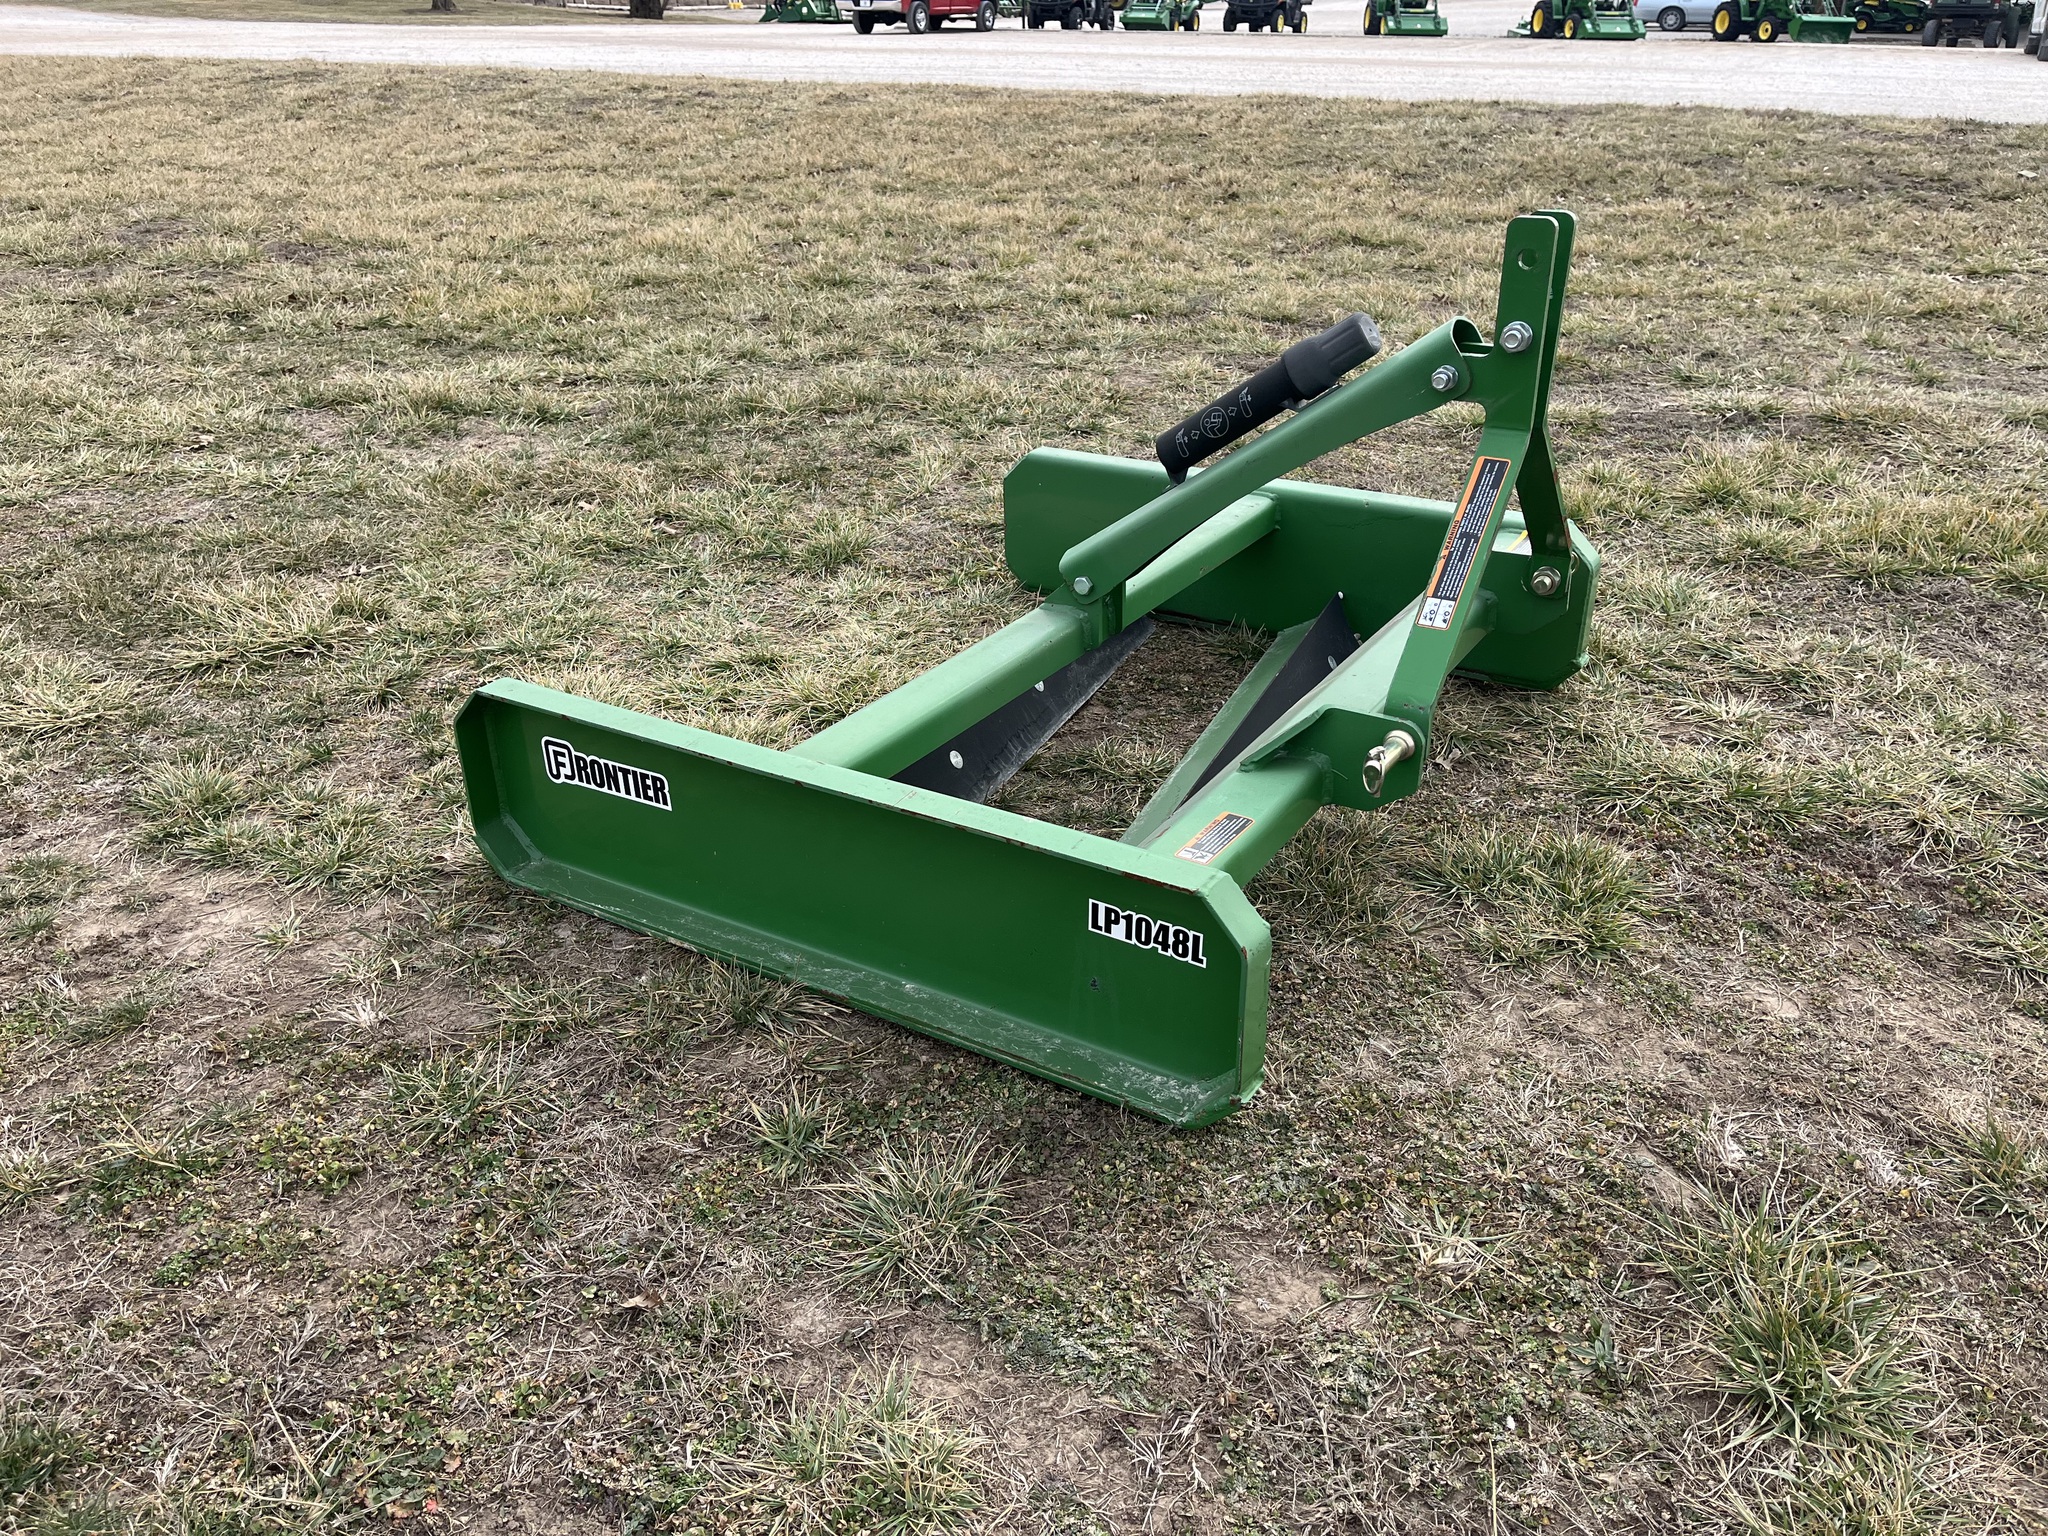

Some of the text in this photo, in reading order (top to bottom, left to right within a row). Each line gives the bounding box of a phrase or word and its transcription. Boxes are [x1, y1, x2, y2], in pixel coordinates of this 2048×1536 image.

[1444, 519, 1460, 551] WARNING
[543, 738, 670, 808] FRONTIER
[1090, 901, 1205, 966] LP1048L
